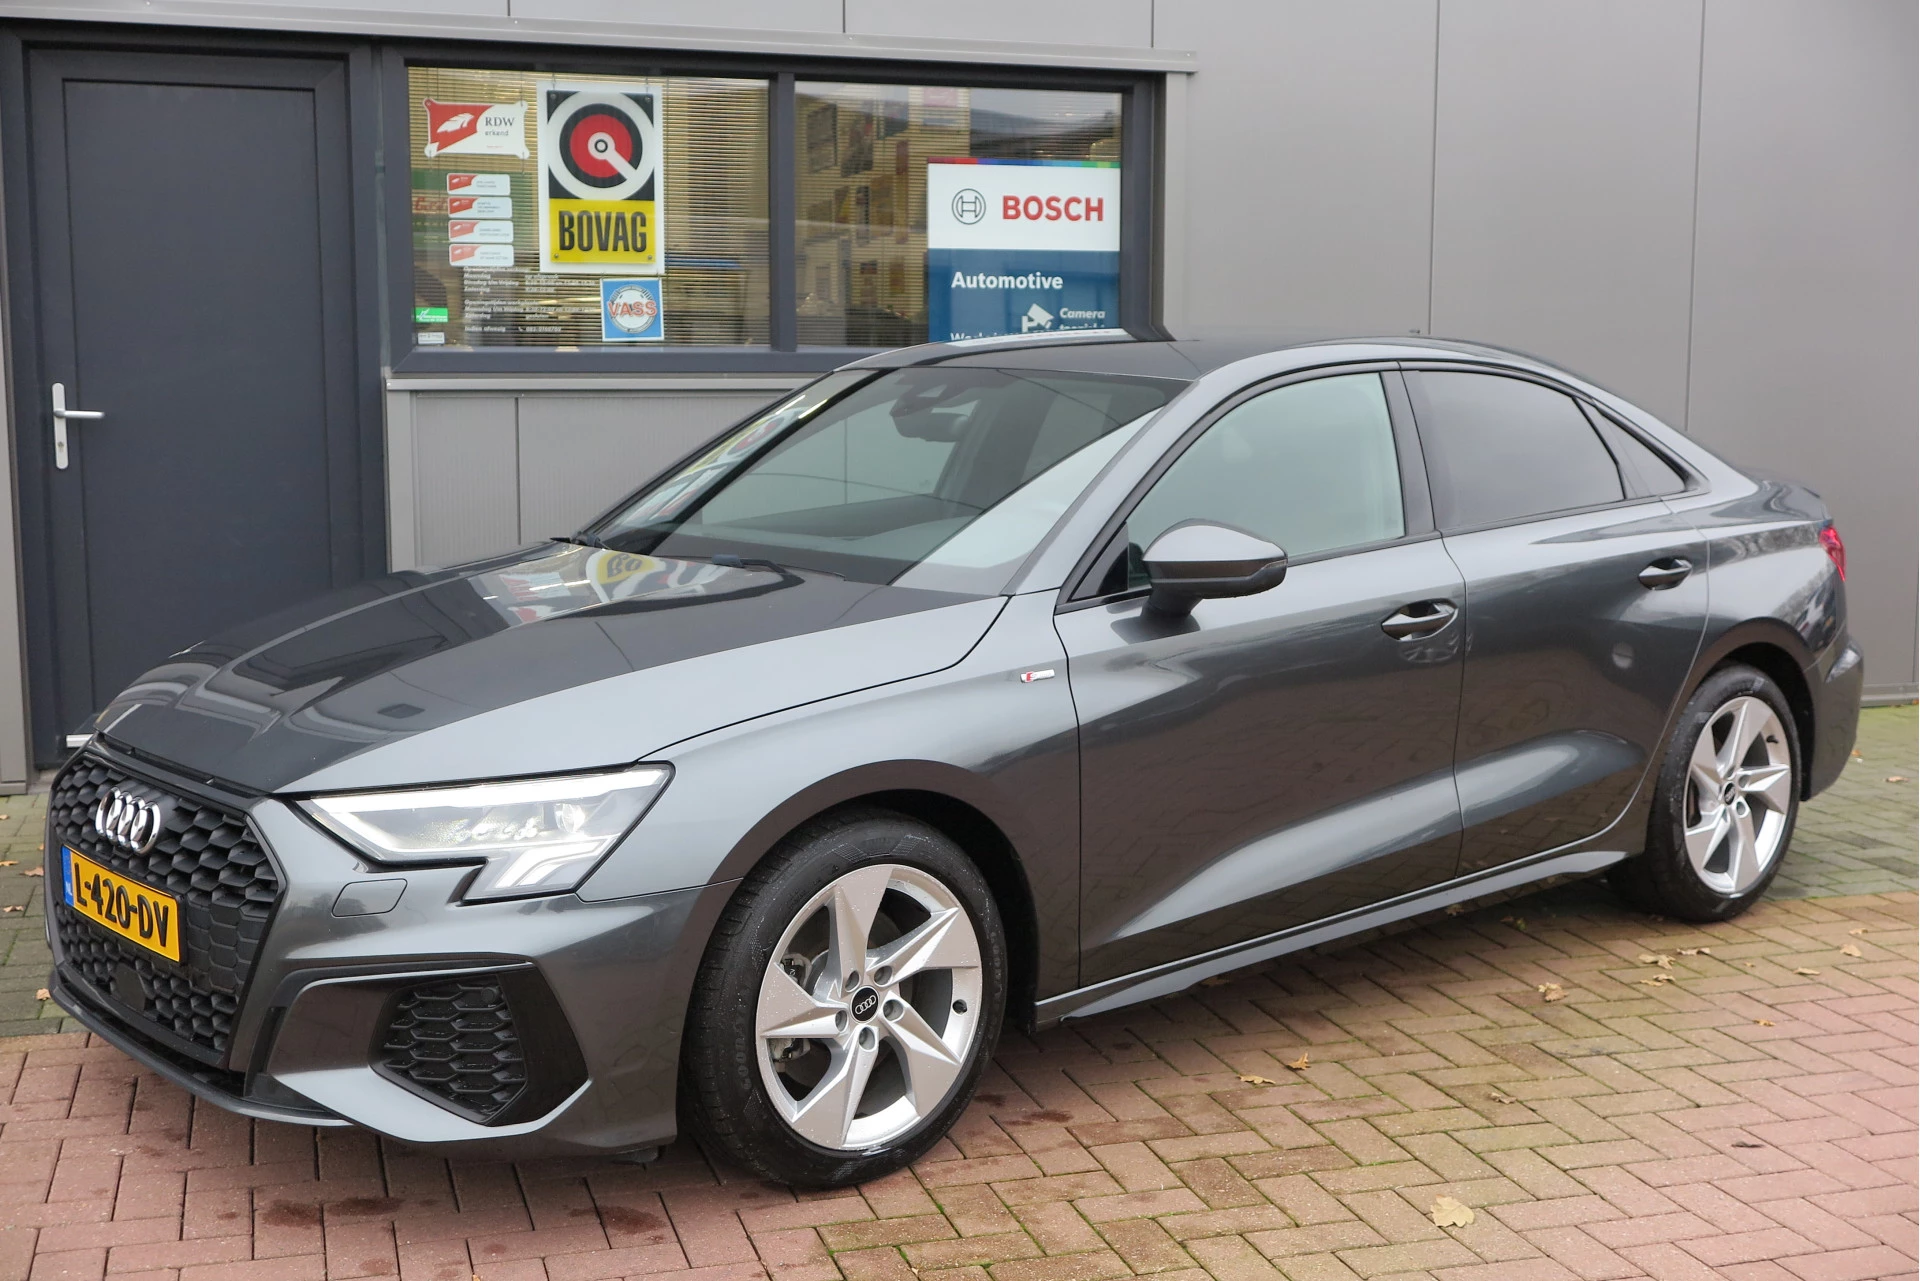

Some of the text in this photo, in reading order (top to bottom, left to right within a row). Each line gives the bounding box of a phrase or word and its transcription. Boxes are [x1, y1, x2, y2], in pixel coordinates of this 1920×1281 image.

[485, 116, 515, 127] RDW
[1002, 195, 1104, 221] BOSCH
[558, 210, 647, 252] BOVAG
[951, 271, 1063, 289] Automotive
[608, 300, 658, 317] VASS
[1060, 308, 1105, 319] Camera
[74, 862, 169, 948] L-420-DV
